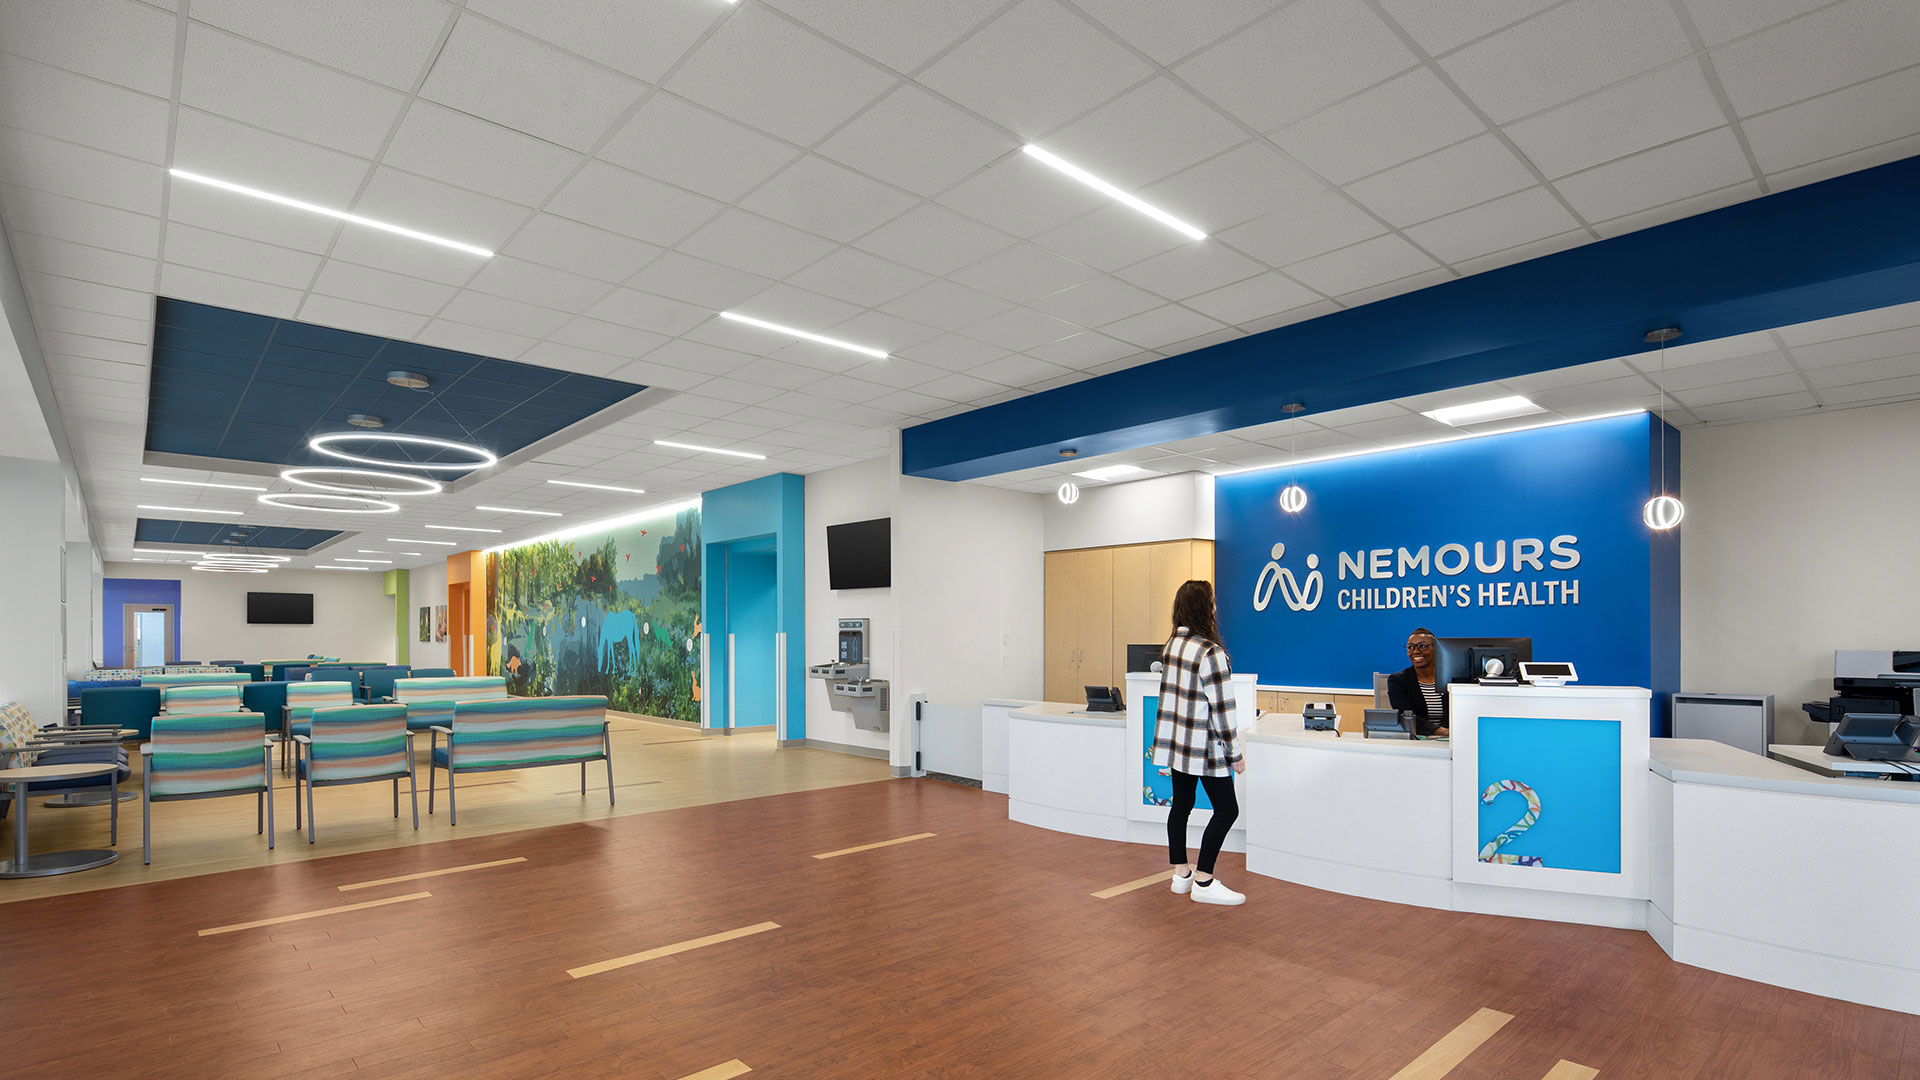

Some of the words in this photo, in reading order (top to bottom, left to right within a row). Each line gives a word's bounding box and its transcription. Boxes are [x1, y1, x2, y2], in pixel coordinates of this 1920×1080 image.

[1338, 534, 1581, 581] NEMOURS
[1337, 583, 1471, 610] CHILDREN'S
[1478, 579, 1580, 608] HEALTH
[1477, 779, 1543, 868] 2
